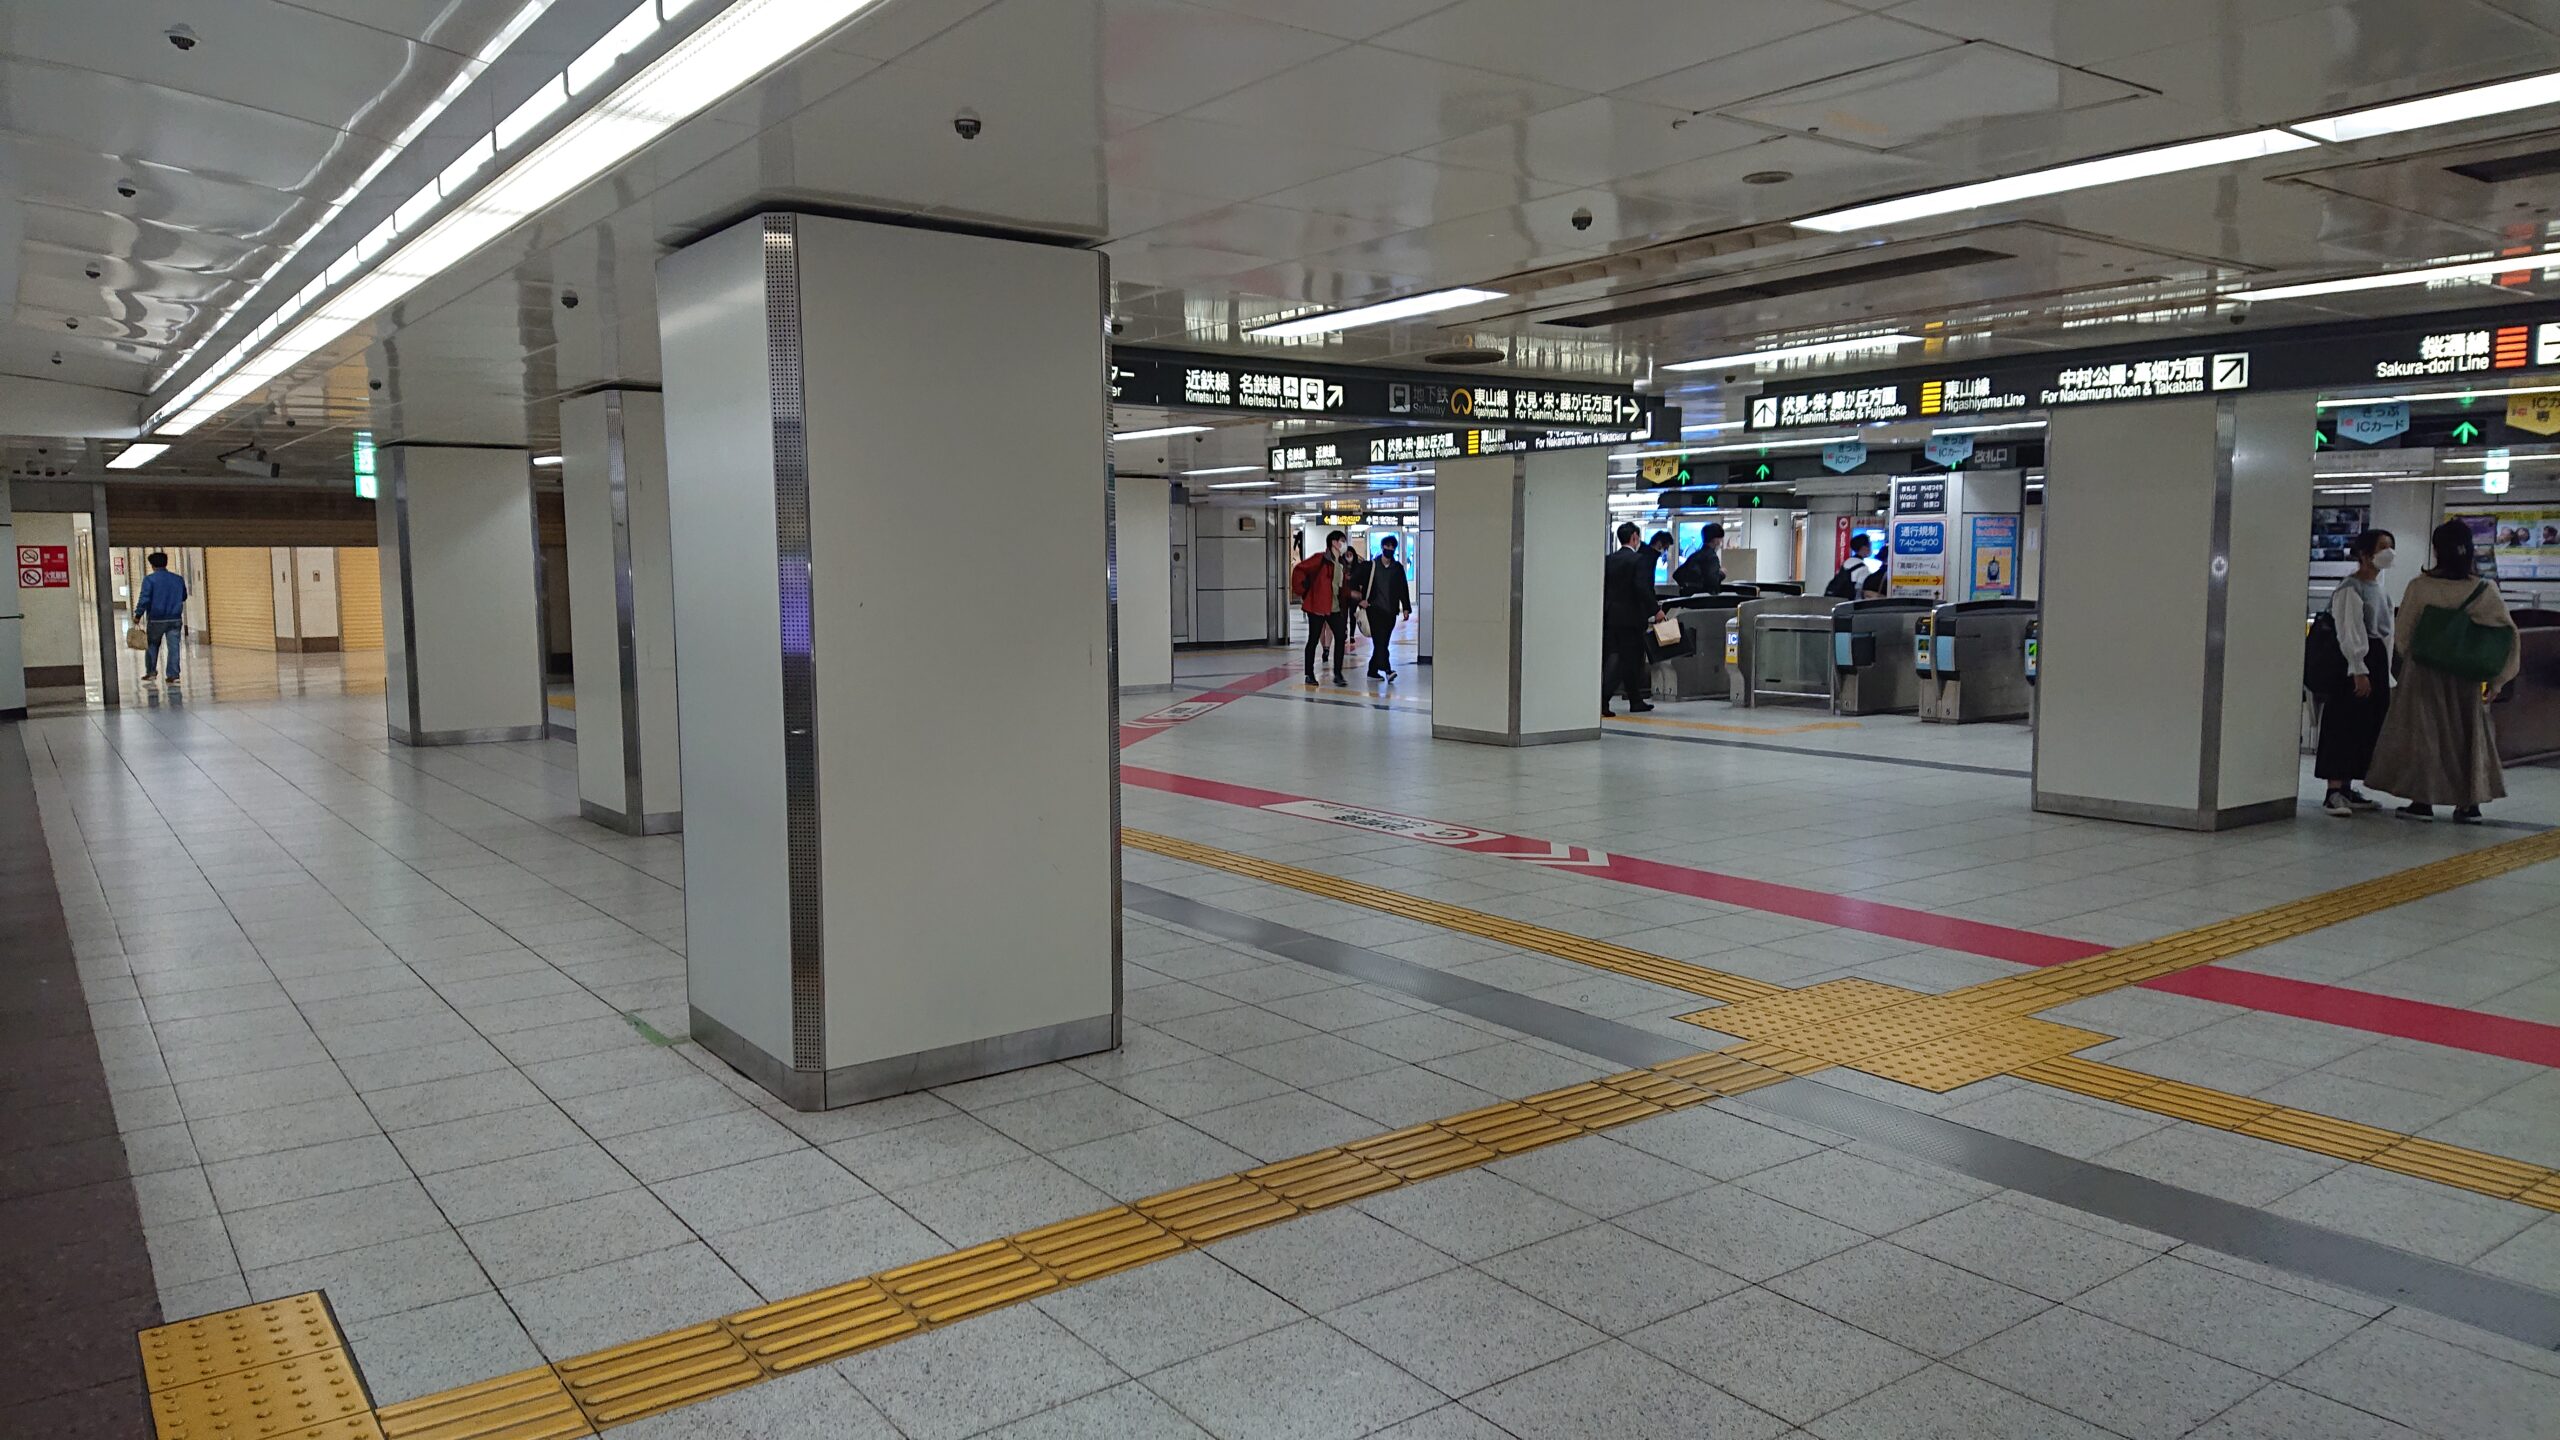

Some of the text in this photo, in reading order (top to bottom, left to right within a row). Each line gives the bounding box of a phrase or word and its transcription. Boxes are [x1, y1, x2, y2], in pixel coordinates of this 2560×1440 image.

[2376, 356, 2490, 378] Sakura-dori Line
[1185, 368, 1230, 391] 近鉄線
[1239, 373, 1281, 396] 名鉄線
[1185, 389, 1230, 405] Kintetsu Line
[1413, 385, 1449, 404] 地下鉄
[1945, 378, 1990, 400] 東山線
[2040, 378, 2204, 404] For Nakamura Koen & Takabata
[1239, 394, 1299, 409] Meitetsu Line
[1473, 388, 1509, 407] 東山線
[1944, 393, 2026, 414] Higashiyama Line
[1413, 402, 1446, 416] Subway
[1473, 406, 1509, 419] Higashiyama Line
[1515, 407, 1526, 419] For
[1576, 411, 1582, 421] &
[1582, 411, 1612, 424] Fujigaoka
[1781, 404, 1907, 426] For Fushimi, Sakae & Fujigaoka
[2356, 419, 2405, 433] ICカード
[1514, 439, 1527, 449] Line
[1535, 438, 1546, 449] For
[1546, 435, 1576, 448] Nakamura
[1576, 433, 1592, 445] Koen
[1593, 432, 1599, 443] &
[1387, 451, 1396, 461] For
[1835, 453, 1863, 464] ICカード
[1938, 447, 1969, 458] ICカード
[1975, 449, 2007, 463] 改札口
[1901, 525, 1938, 537] 通行規制
[1728, 633, 1738, 645] IC
